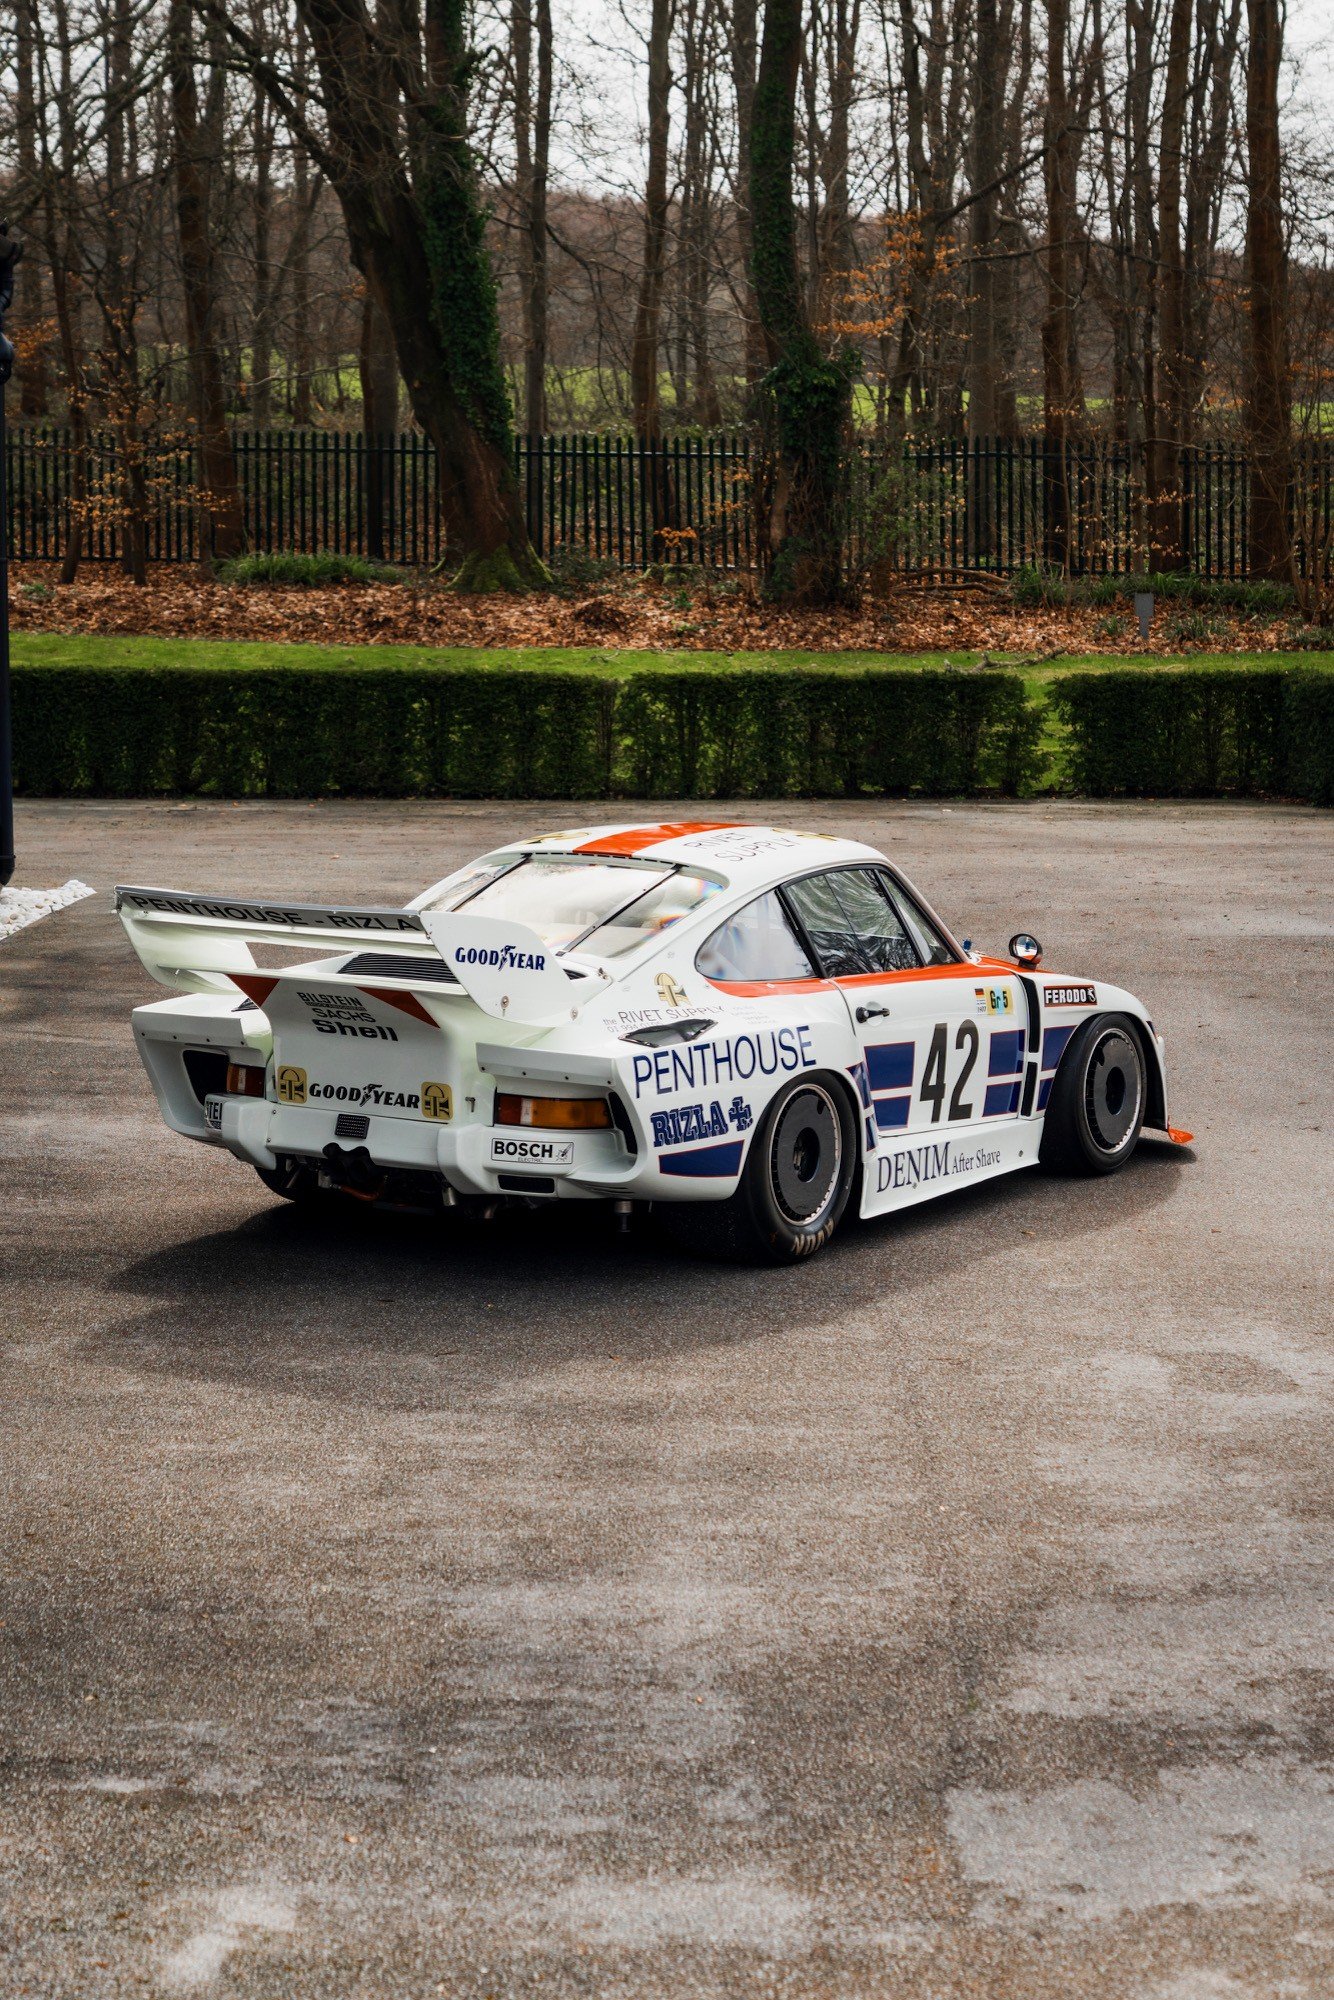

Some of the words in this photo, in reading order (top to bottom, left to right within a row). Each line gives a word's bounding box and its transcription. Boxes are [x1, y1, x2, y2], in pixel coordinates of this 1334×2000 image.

[684, 832, 751, 849] RIVET
[715, 837, 799, 862] SUPPLY
[128, 895, 308, 926] PENTHOUSE
[327, 915, 420, 932] RIZLA
[296, 991, 363, 1007] BILSTEIN
[1045, 988, 1087, 1004] FERODO
[312, 1007, 376, 1023] SACHS
[603, 1017, 617, 1026] the
[618, 1009, 662, 1024] RIVET
[668, 1005, 725, 1020] SUPPLY
[312, 1019, 399, 1042] Shell
[632, 1025, 817, 1099] PENTHOUSE
[919, 1018, 980, 1124] 42
[494, 1140, 553, 1158] BOSCH
[876, 1141, 951, 1193] DENIM
[952, 1152, 975, 1175] After
[976, 1148, 1001, 1169] Shave
